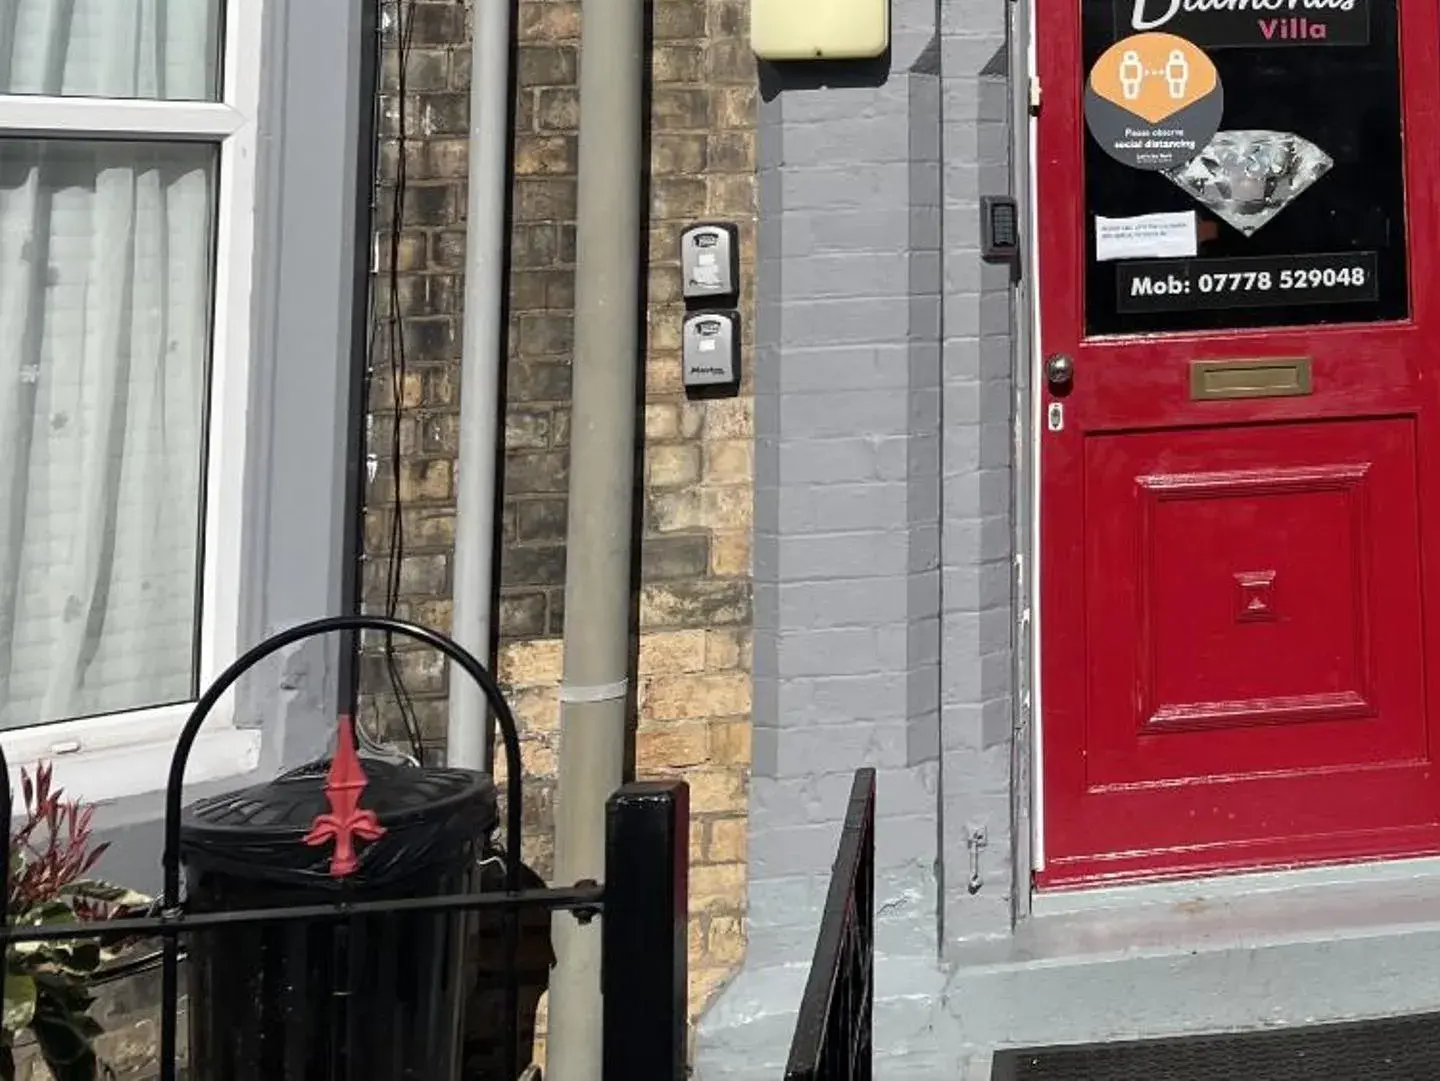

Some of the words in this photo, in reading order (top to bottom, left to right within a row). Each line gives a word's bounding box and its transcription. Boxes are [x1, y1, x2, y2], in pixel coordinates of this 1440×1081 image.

[1257, 16, 1327, 40] Villa
[1130, 274, 1191, 296] Mob:
[1198, 271, 1272, 293] 07778
[1279, 267, 1365, 290] 529048
